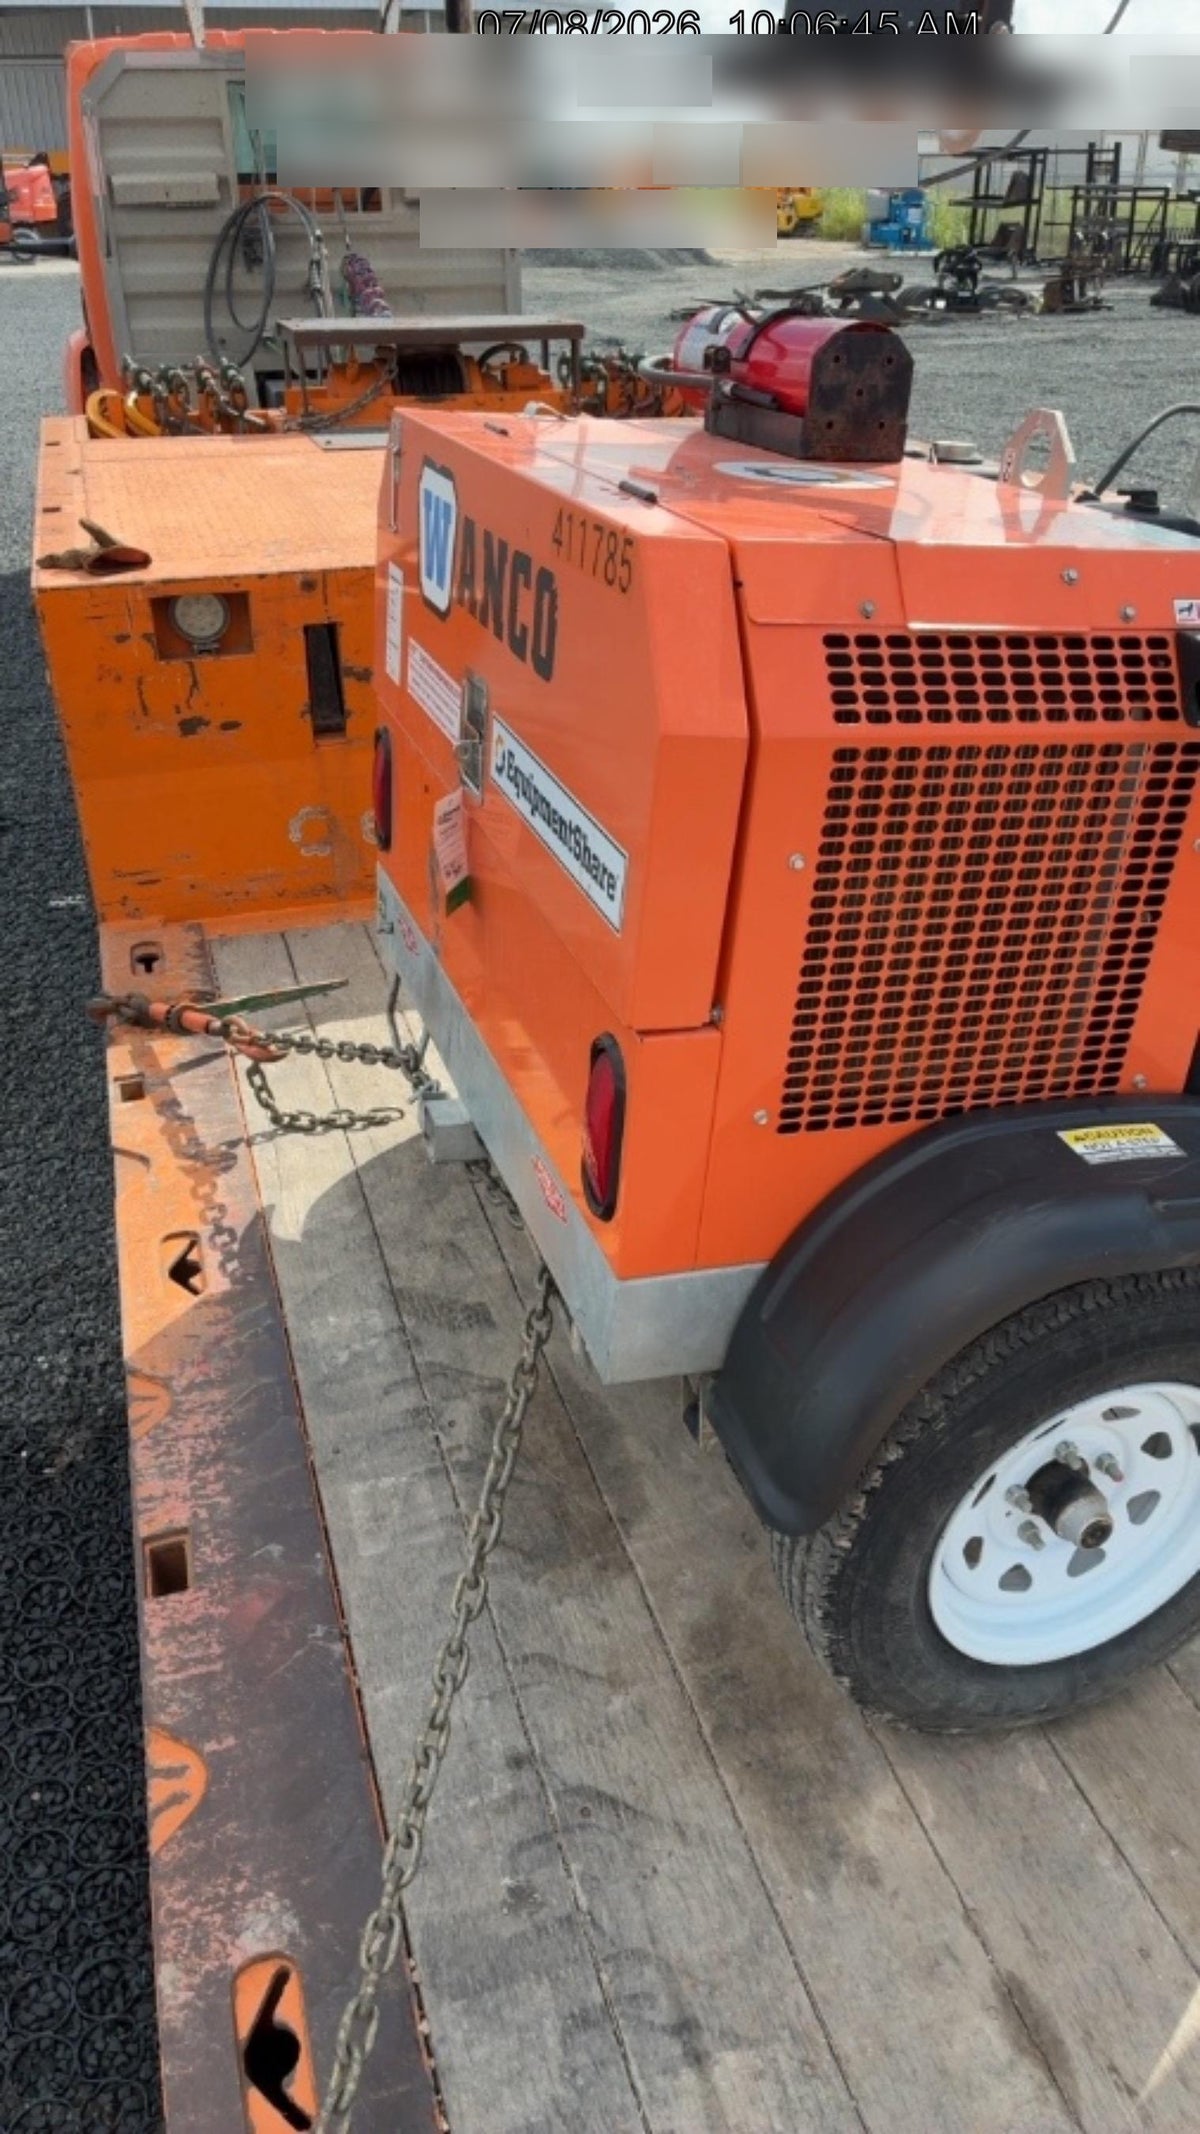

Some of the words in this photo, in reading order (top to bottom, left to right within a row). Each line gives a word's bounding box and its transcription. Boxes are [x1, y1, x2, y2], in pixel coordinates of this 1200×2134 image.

[418, 456, 558, 682] WANCO
[552, 508, 635, 593] 411785
[506, 748, 617, 902] EquipmentShare
